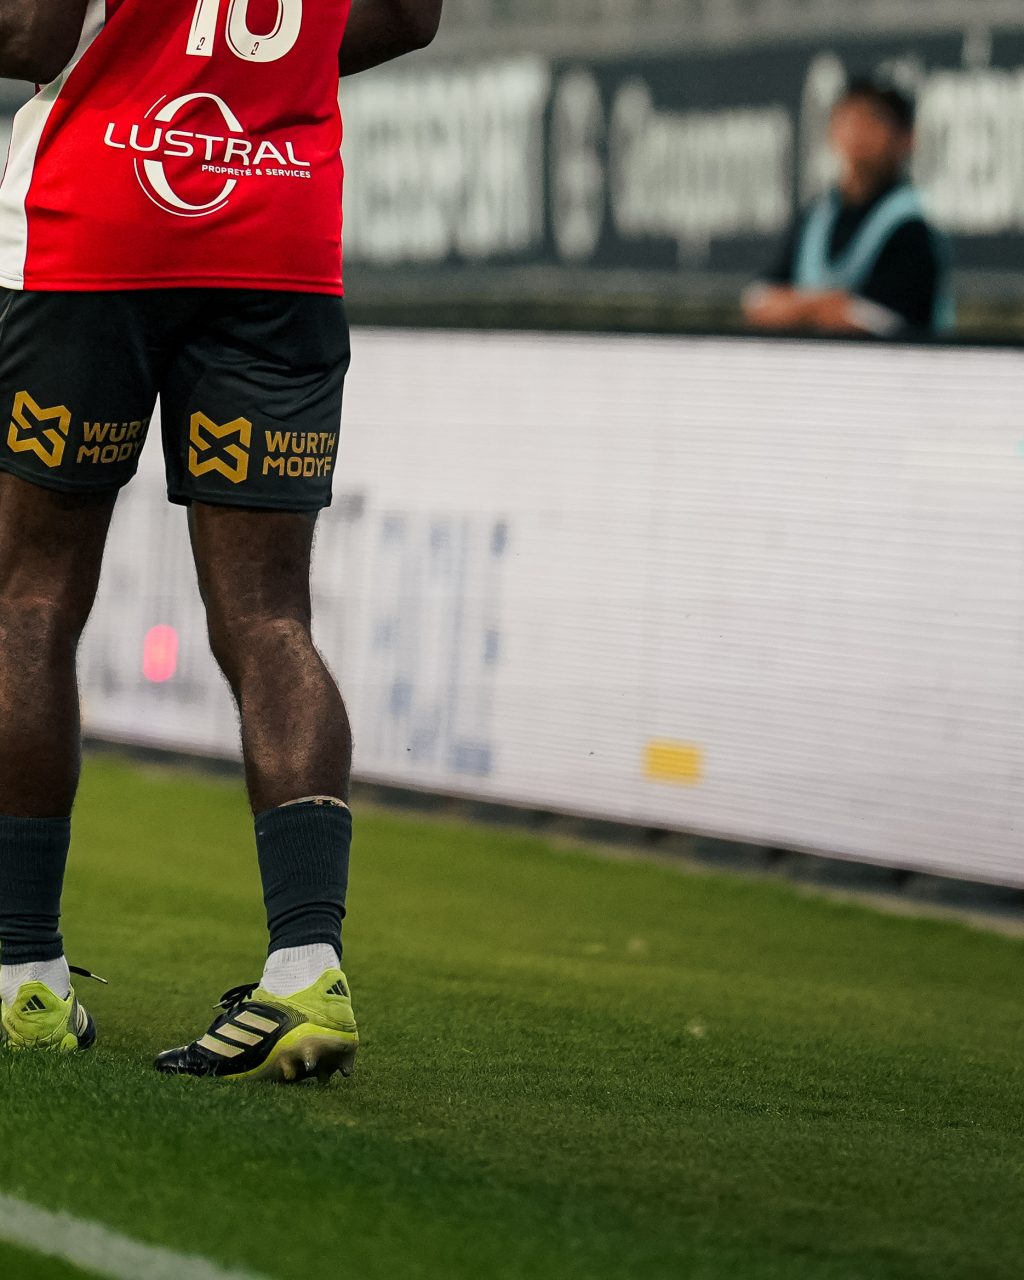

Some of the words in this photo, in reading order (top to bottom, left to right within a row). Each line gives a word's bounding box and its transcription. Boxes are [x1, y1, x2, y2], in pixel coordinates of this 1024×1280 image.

[103, 122, 311, 167] LUSTRAL
[201, 164, 252, 177] PROPRETÉ
[255, 168, 262, 176] &
[265, 168, 311, 179] SERVICES
[264, 430, 336, 454] WÜRTH
[262, 455, 332, 477] MODYF
